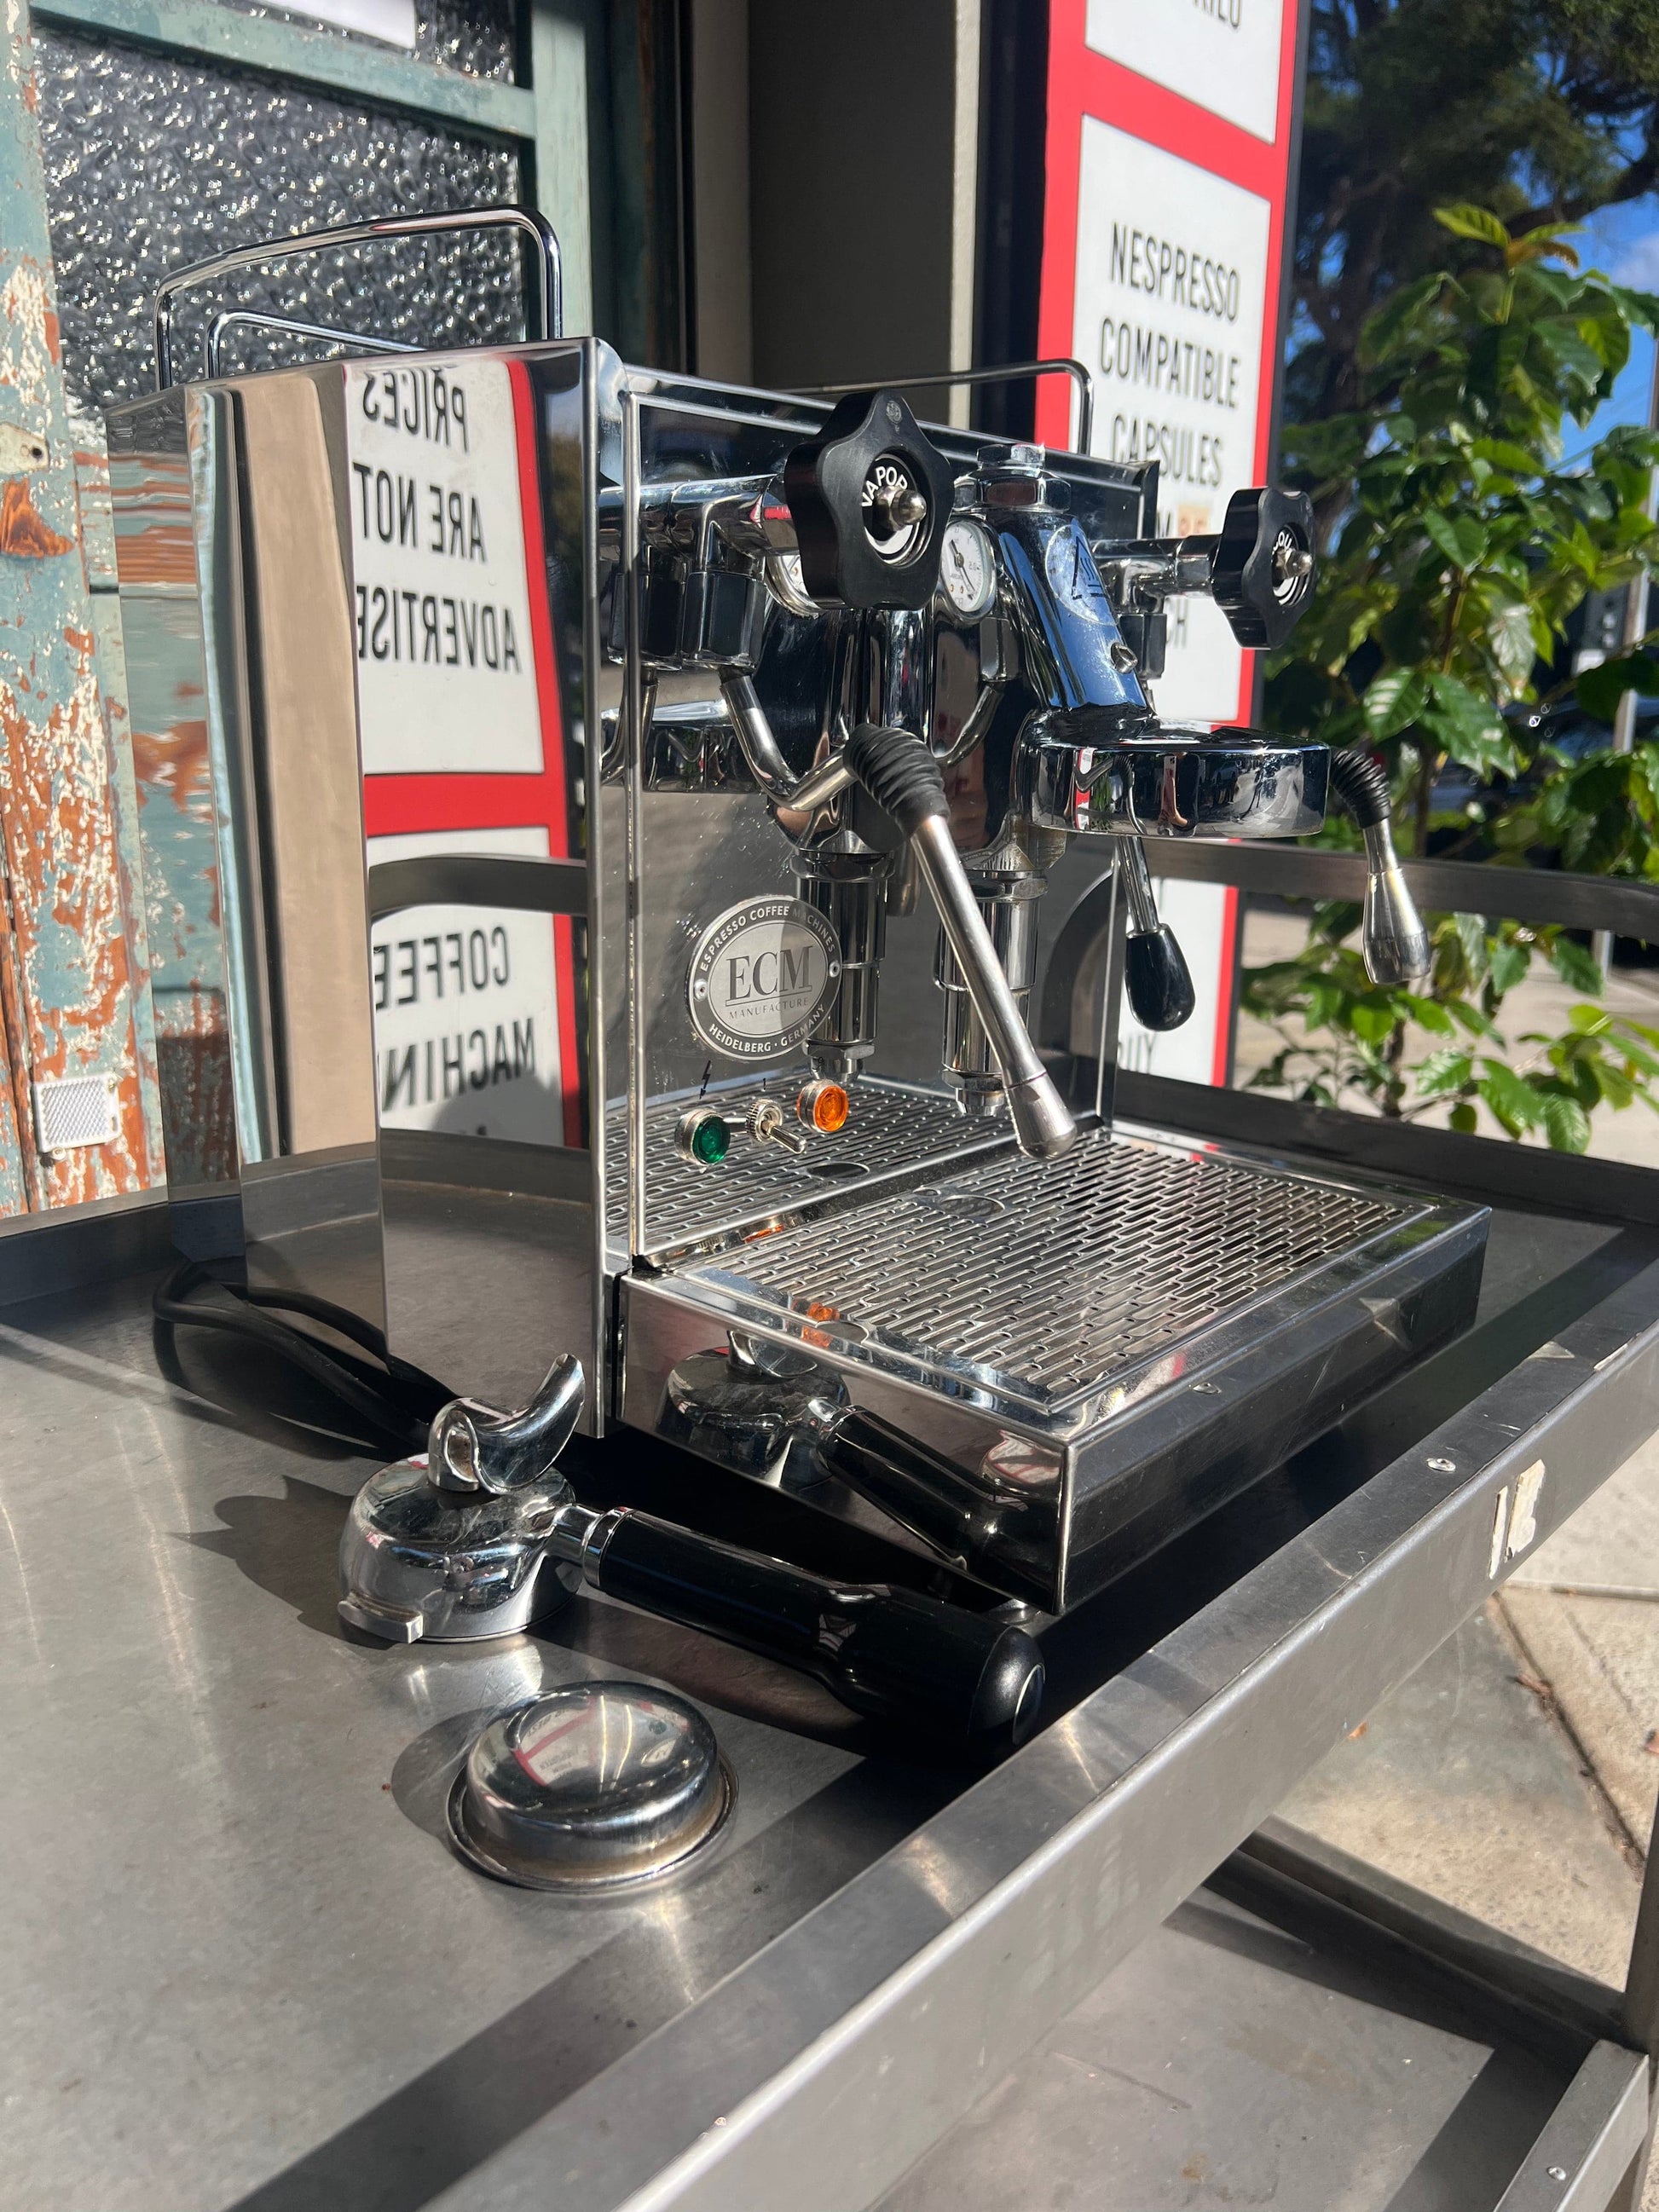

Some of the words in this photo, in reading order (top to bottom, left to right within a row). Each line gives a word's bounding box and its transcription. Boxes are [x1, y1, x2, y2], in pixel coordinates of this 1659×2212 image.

[1111, 222, 1240, 322] NESPRESSO
[1100, 317, 1241, 409] COMPATIBLE
[1112, 414, 1223, 487] CAPSULES
[699, 915, 747, 973] ESPRESSO
[749, 905, 790, 921] COFFEE
[793, 908, 835, 953] MACHINES
[725, 945, 813, 1002] ECM
[708, 1023, 772, 1053] HEIDELBERG
[780, 1003, 825, 1047] GERMANY
[728, 997, 810, 1020] MANUFACTURE
